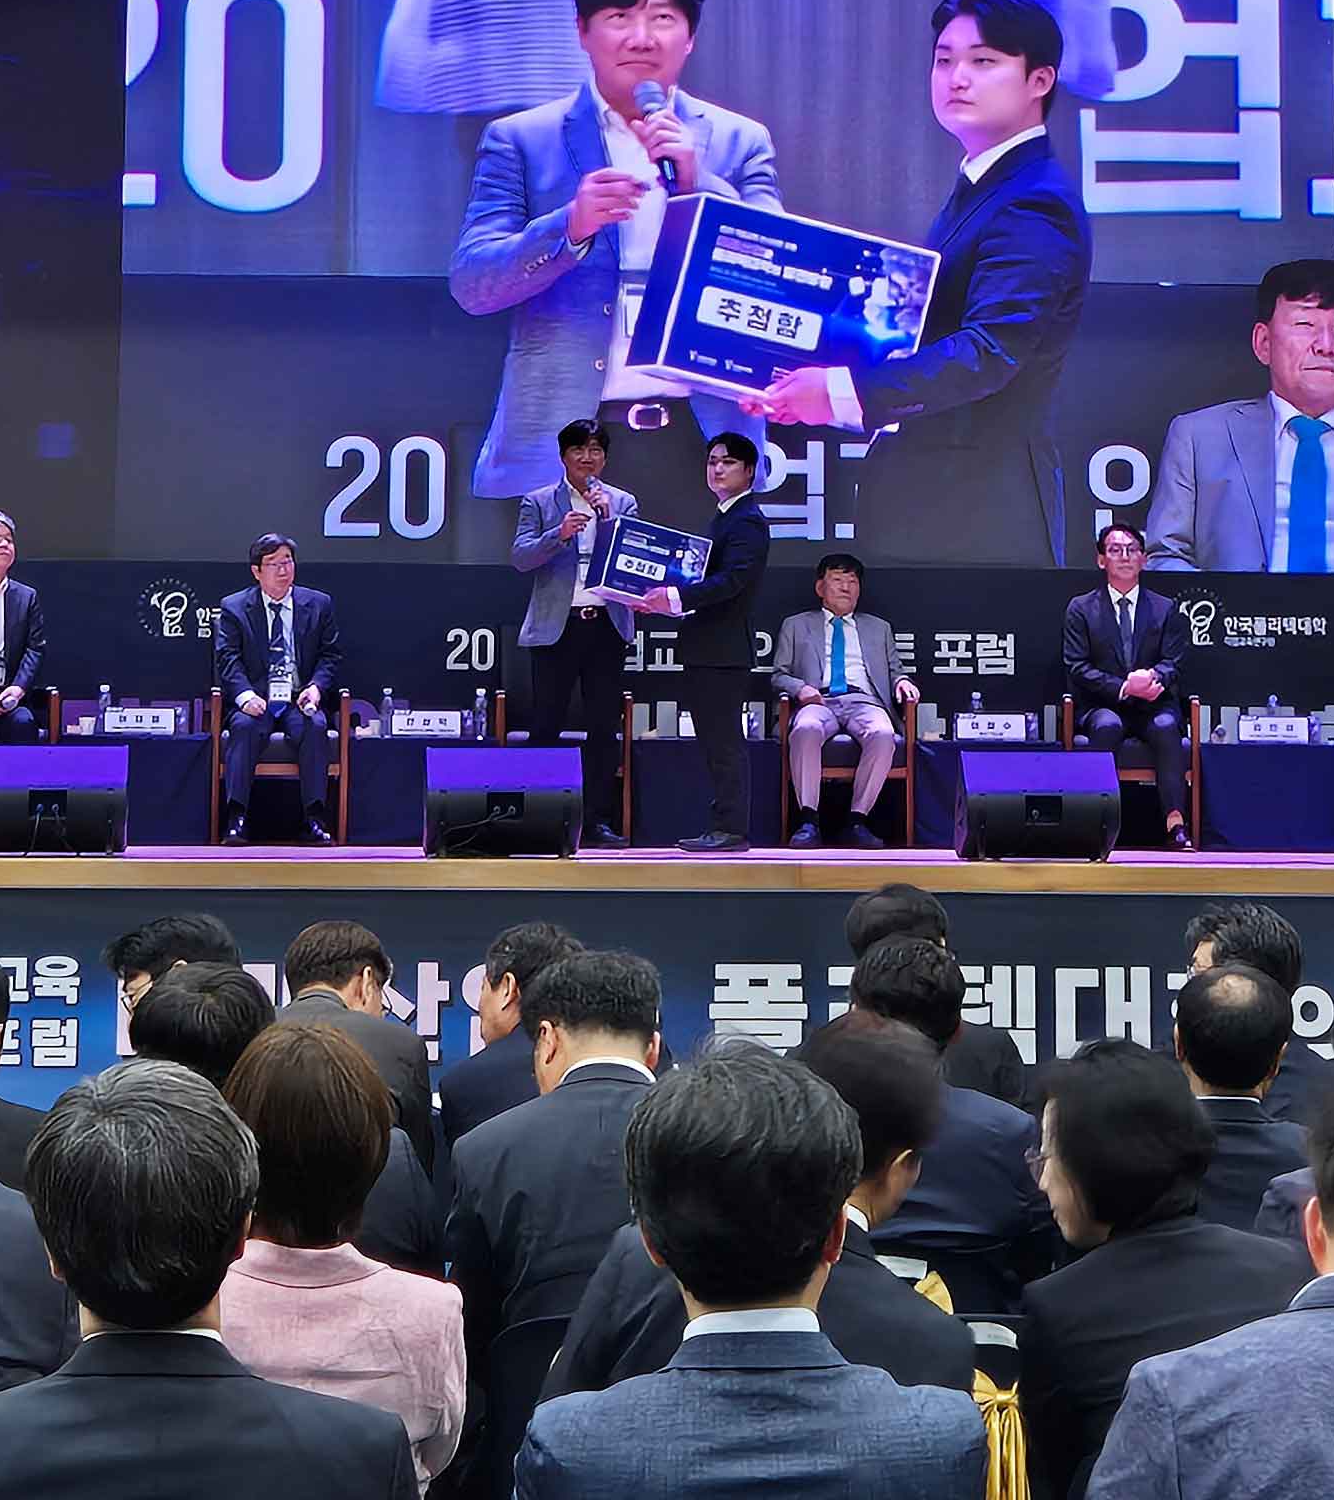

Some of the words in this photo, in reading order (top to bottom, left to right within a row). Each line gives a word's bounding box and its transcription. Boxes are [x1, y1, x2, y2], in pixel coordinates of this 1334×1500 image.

[323, 435, 447, 540] 20
[445, 627, 497, 672] 20
[932, 633, 1016, 676] 포럼
